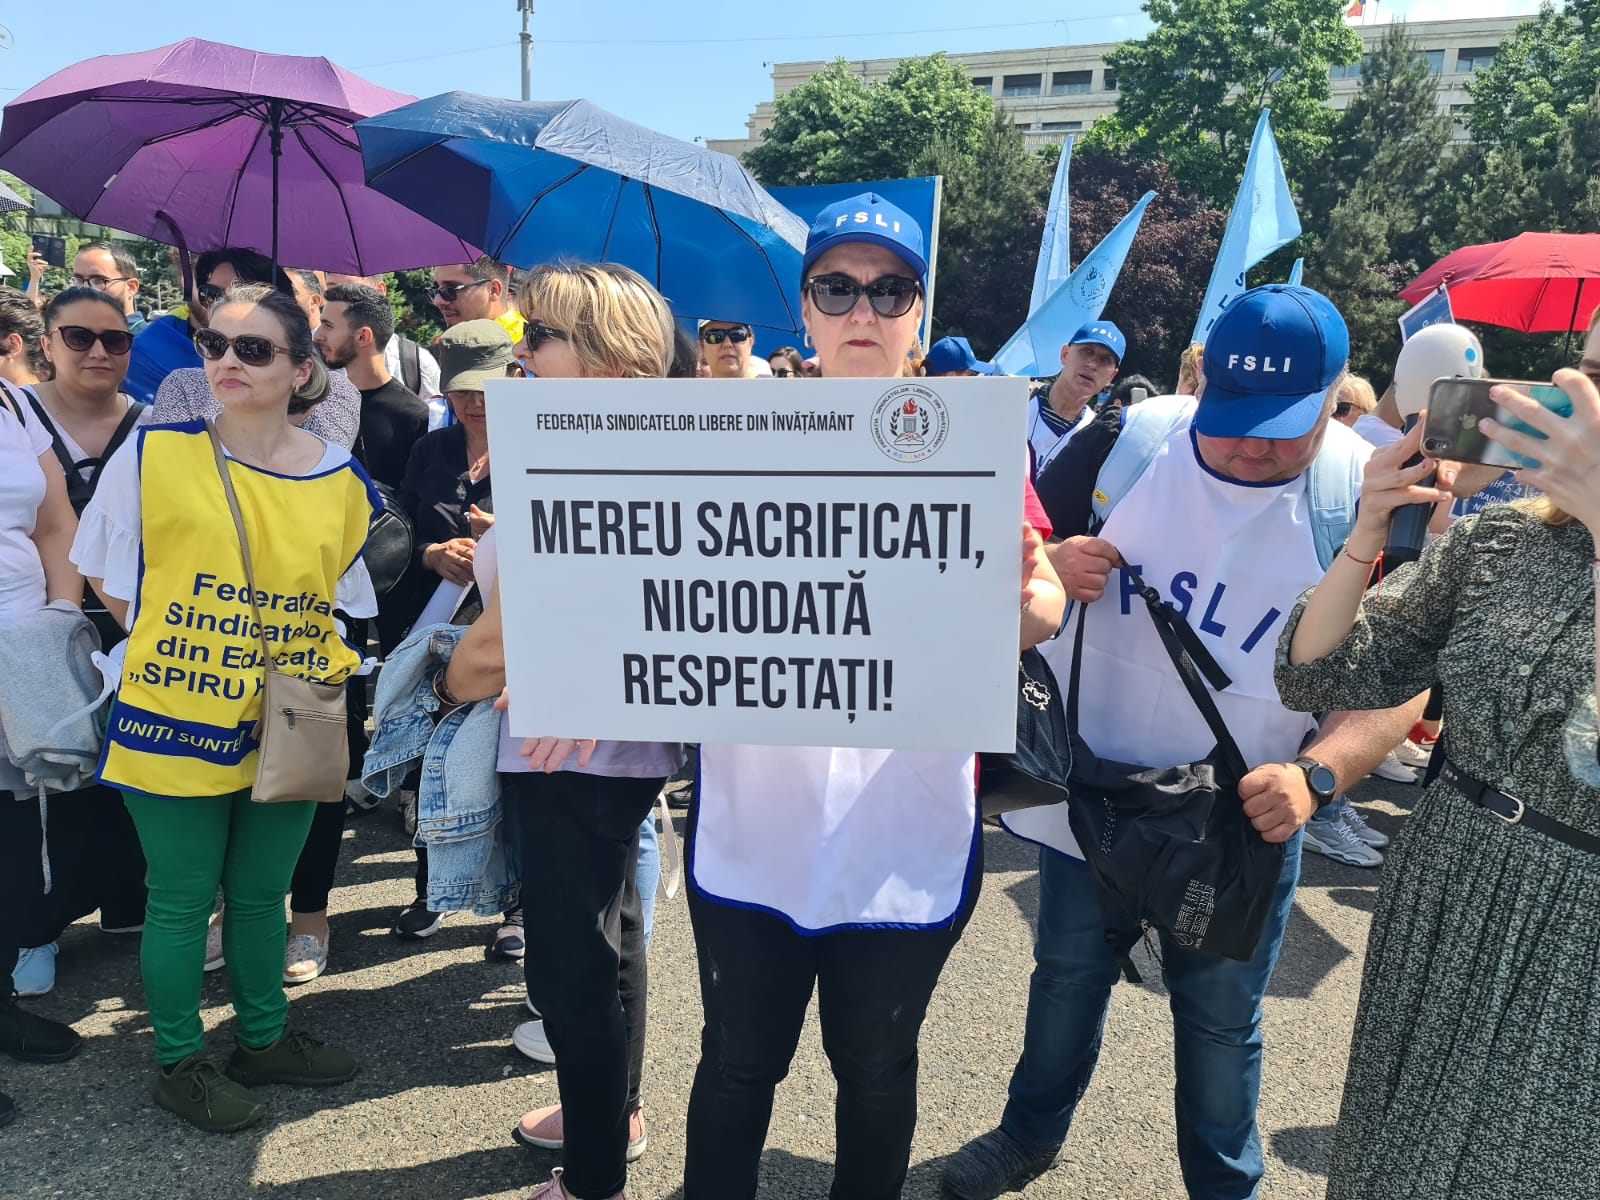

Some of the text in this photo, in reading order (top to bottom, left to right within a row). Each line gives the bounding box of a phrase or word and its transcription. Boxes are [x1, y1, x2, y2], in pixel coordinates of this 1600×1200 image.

[835, 211, 900, 233] FSLI
[1205, 271, 1245, 332] SLI
[1092, 327, 1118, 343] FSLI
[1227, 354, 1291, 373] FSLI
[537, 411, 854, 434] FEDERAȚIA SINDICATELOR LIBERE DIN ÎNVĂȚĂMÂNT
[531, 500, 984, 573] MEREU SACRIFICAȚI,
[193, 573, 331, 618] Federația
[643, 570, 871, 635] NICIODATĂ
[1119, 564, 1281, 654] FSLI
[156, 636, 209, 662] din
[129, 662, 245, 700] „SPIRU
[623, 654, 892, 723] RESPECTAȚI!
[118, 717, 174, 744] UNIȚI
